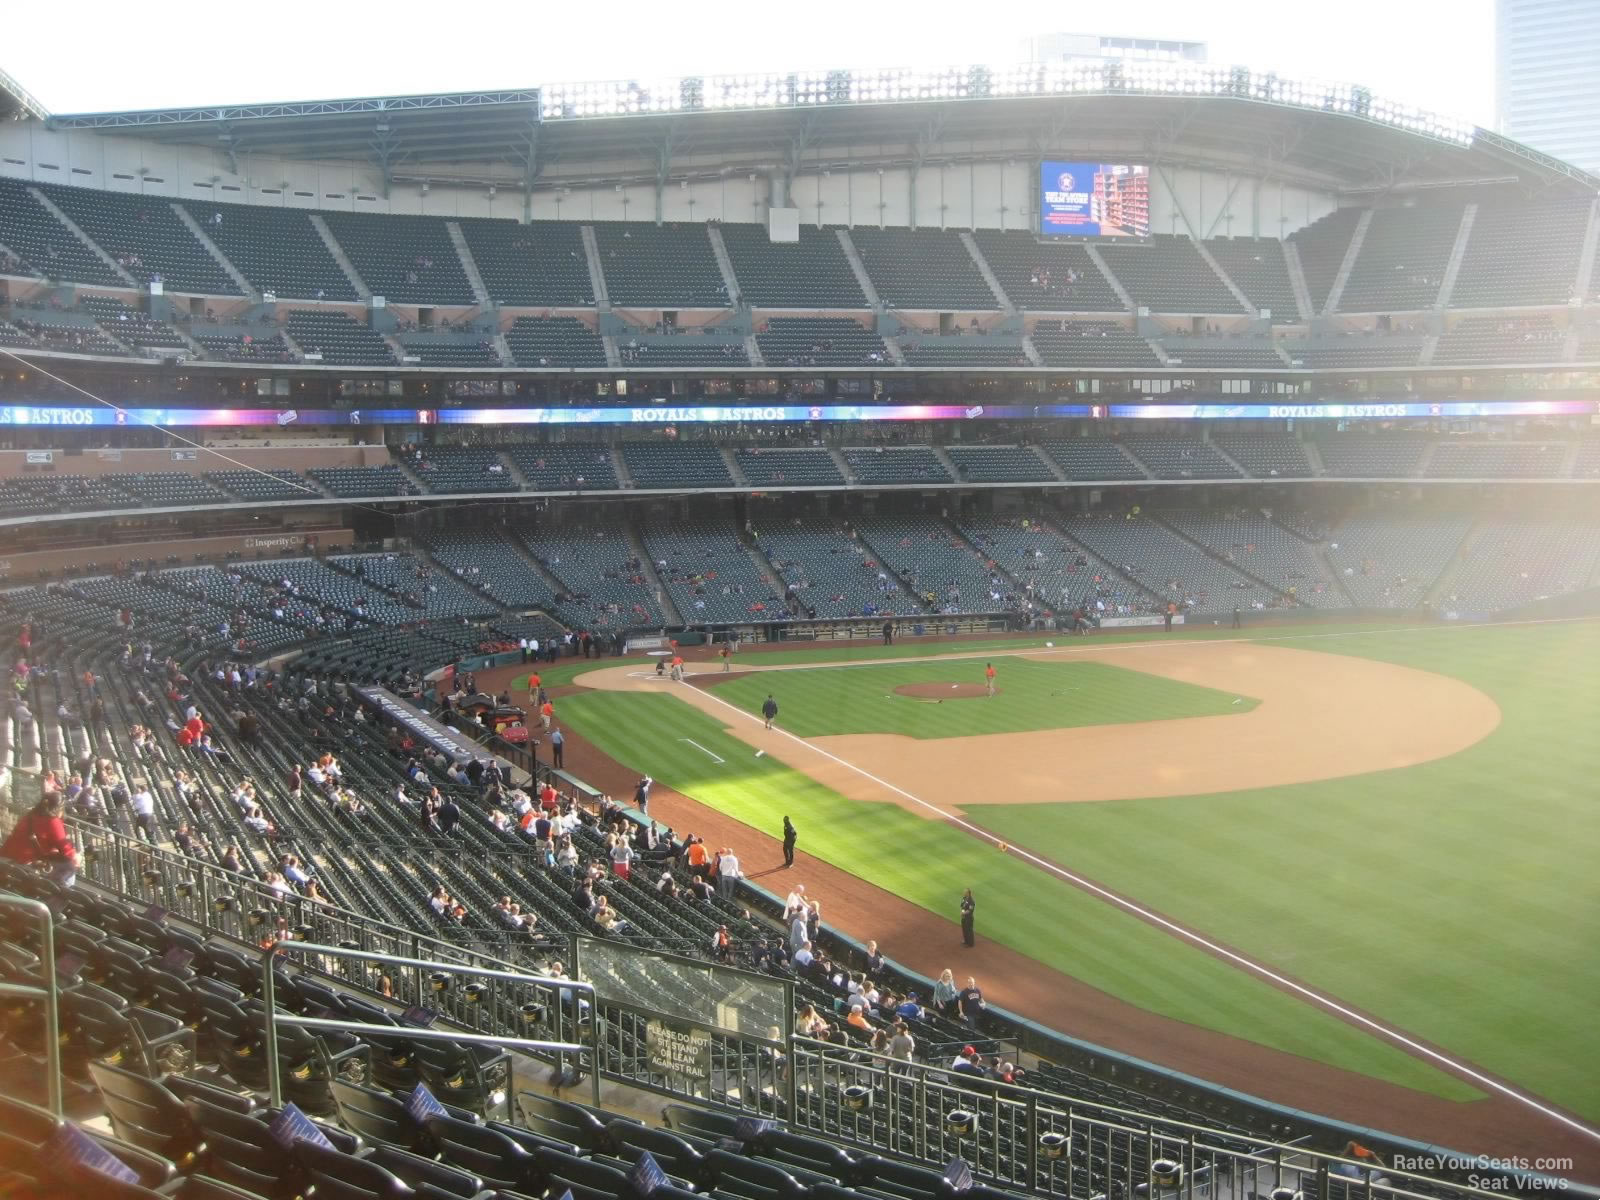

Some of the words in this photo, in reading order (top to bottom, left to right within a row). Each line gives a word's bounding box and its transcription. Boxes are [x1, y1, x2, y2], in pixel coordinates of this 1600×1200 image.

[32, 407, 93, 425] ASTROS
[631, 408, 697, 422] ROYALS
[722, 407, 785, 421] ASTROS
[1268, 405, 1323, 418] ROYALS
[1347, 404, 1406, 417] ASTROS
[255, 537, 289, 549] Insperity
[647, 1024, 677, 1040] PLEASE
[677, 1033, 690, 1043] DO
[690, 1036, 708, 1047] NOT
[671, 1041, 699, 1055] STAND
[660, 1048, 671, 1059] OR
[672, 1051, 695, 1064] LEAN
[652, 1056, 686, 1072] AGAINST
[686, 1065, 706, 1078] RAIL
